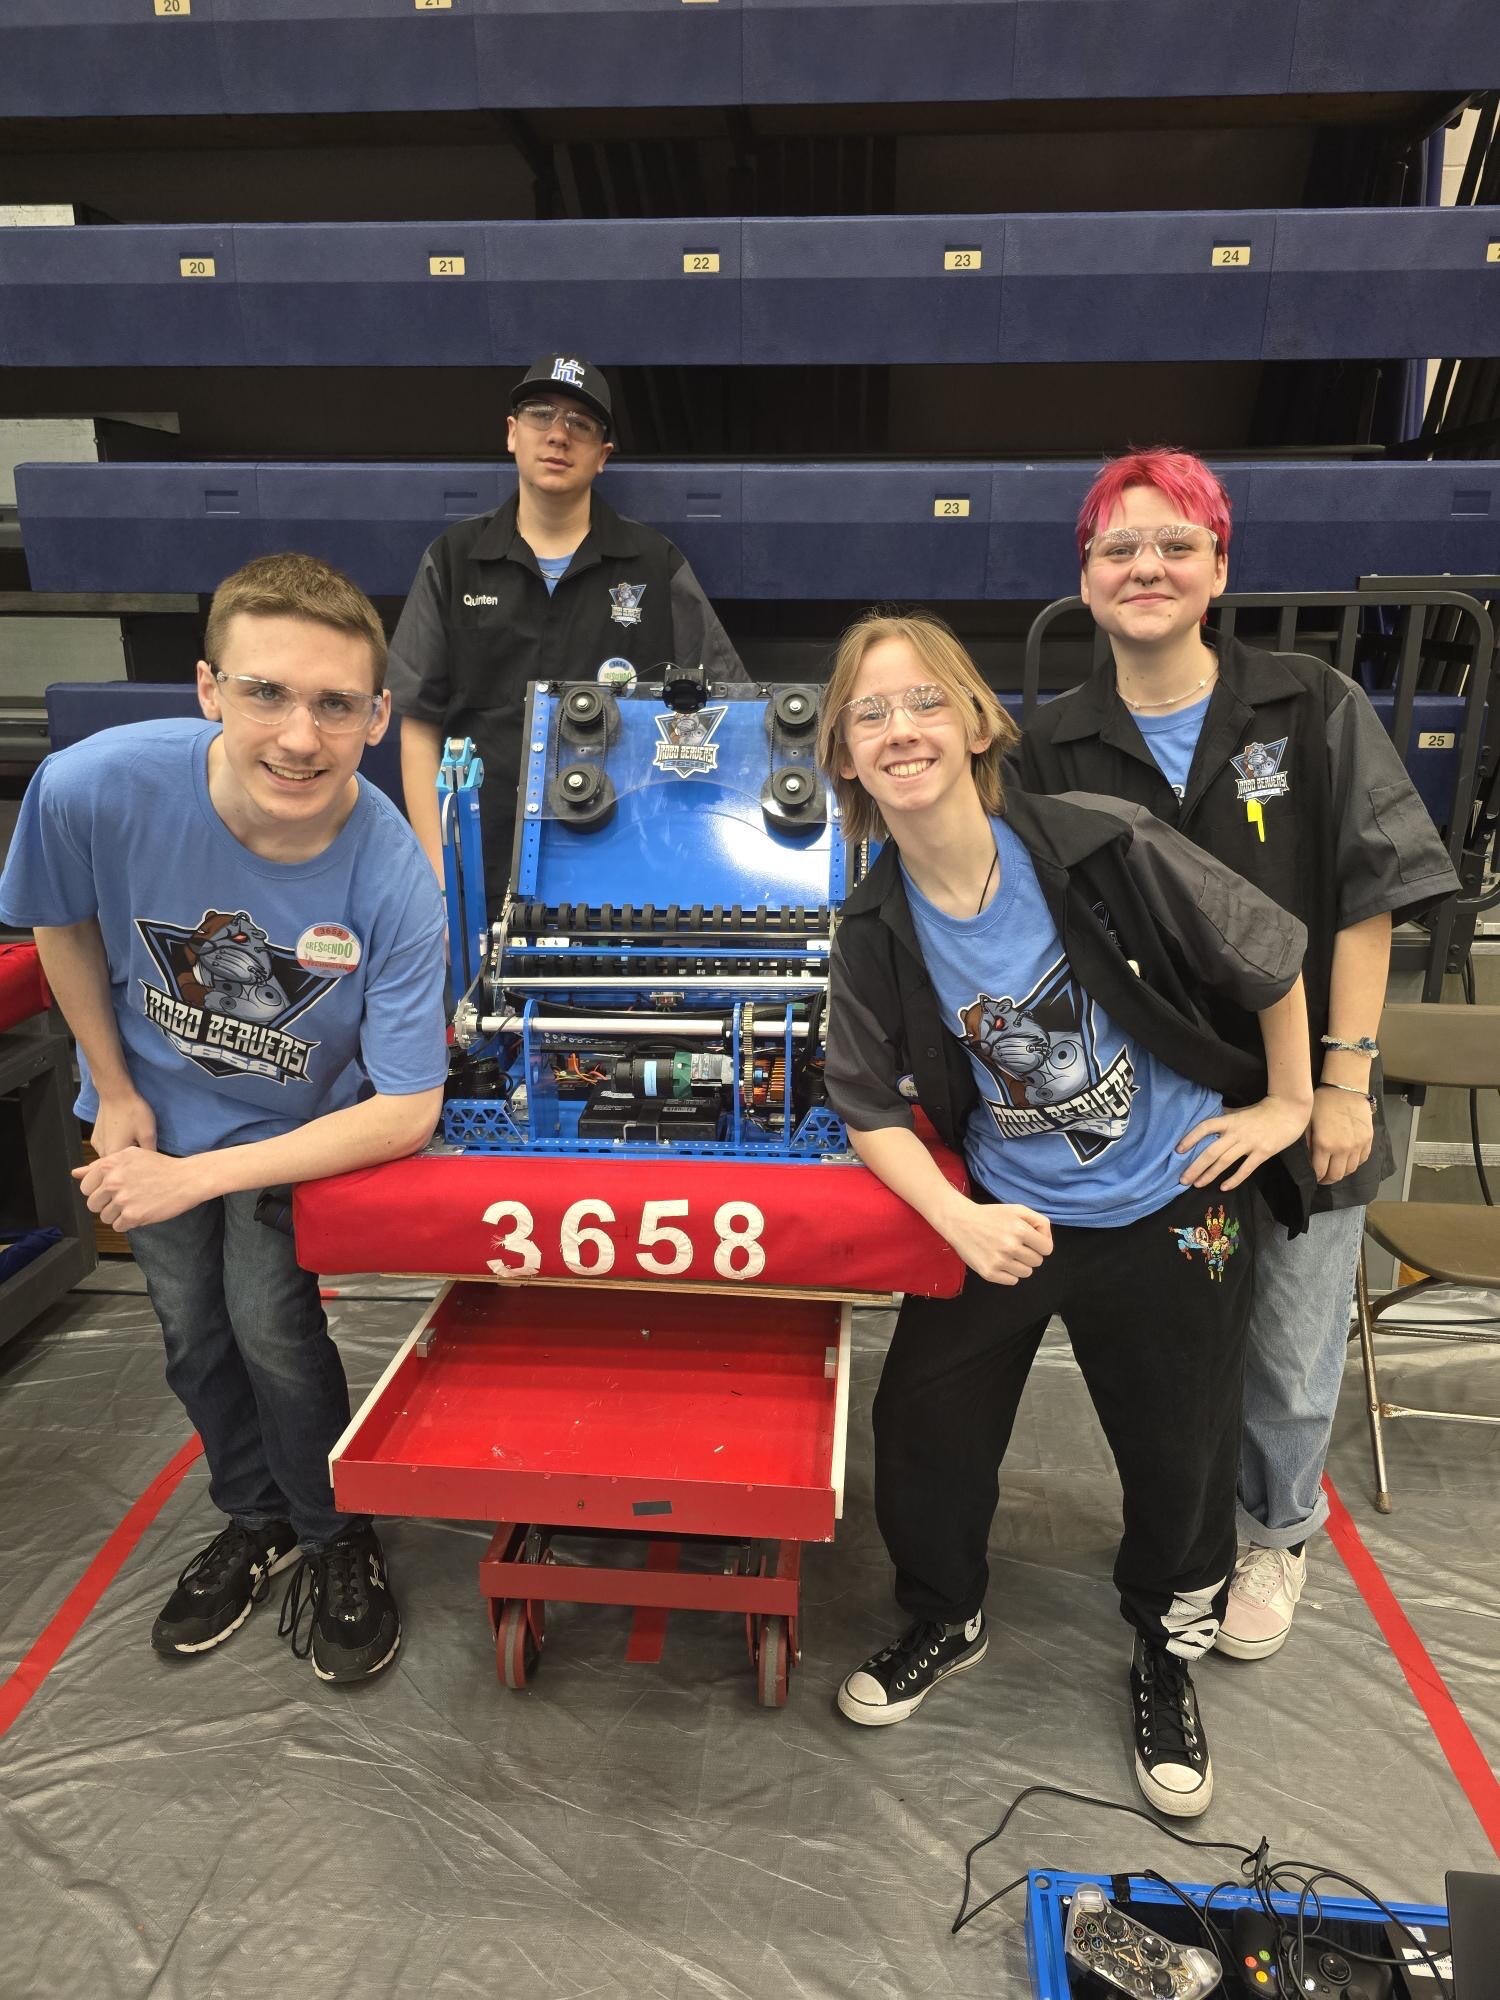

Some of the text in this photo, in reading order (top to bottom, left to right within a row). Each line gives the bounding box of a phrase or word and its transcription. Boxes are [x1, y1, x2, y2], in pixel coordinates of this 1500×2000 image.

[164, 0, 180, 12] 20
[954, 254, 971, 267] 23
[1222, 249, 1240, 263] 24
[189, 261, 206, 274] 20
[439, 260, 454, 273] 21
[693, 257, 710, 270] 22
[943, 502, 960, 514] 23
[463, 594, 498, 607] Quinten
[1427, 735, 1445, 747] 25
[319, 927, 343, 937] 3658
[305, 941, 353, 958] CRESCENDO
[150, 989, 307, 1074] ROBO BEAVERS
[482, 1198, 766, 1281] 3658
